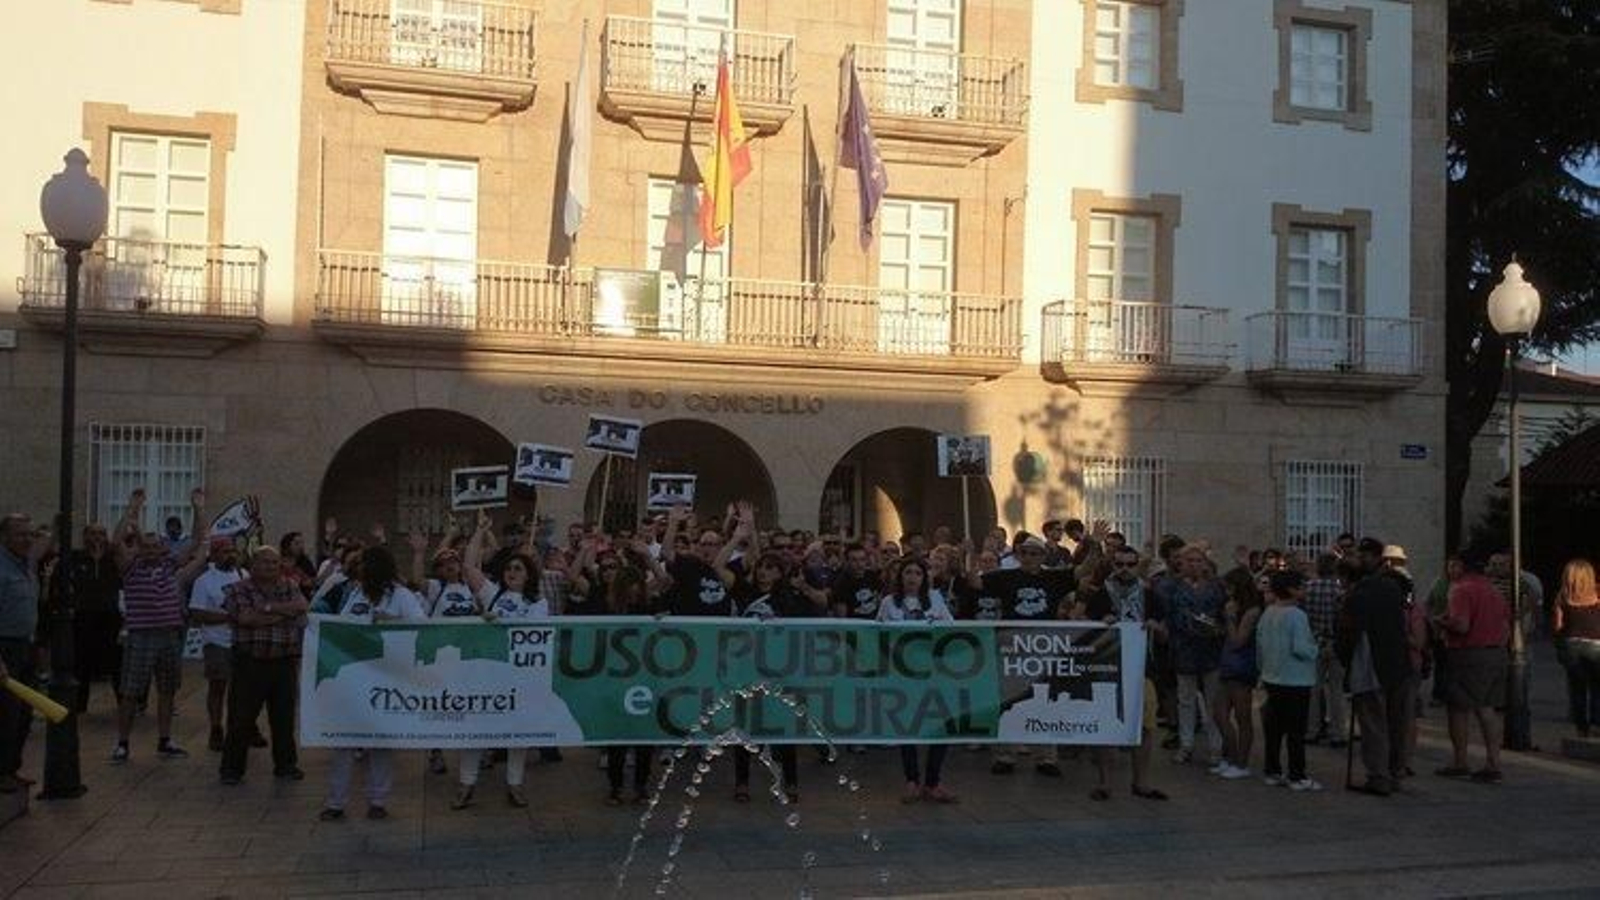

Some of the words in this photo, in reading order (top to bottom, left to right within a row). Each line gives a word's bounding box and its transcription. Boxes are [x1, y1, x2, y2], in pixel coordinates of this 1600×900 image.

[538, 384, 614, 407] CASA
[628, 388, 666, 410] DO
[684, 392, 825, 415] CONCELLO
[510, 629, 552, 649] por
[1012, 634, 1071, 654] NON
[513, 651, 547, 668] un
[558, 627, 698, 680] USO
[1003, 656, 1081, 677] HOTEL
[369, 687, 517, 711] Monterrei
[623, 685, 654, 716] e
[656, 685, 991, 738] CULTURAL
[1024, 716, 1100, 734] Monterrei
